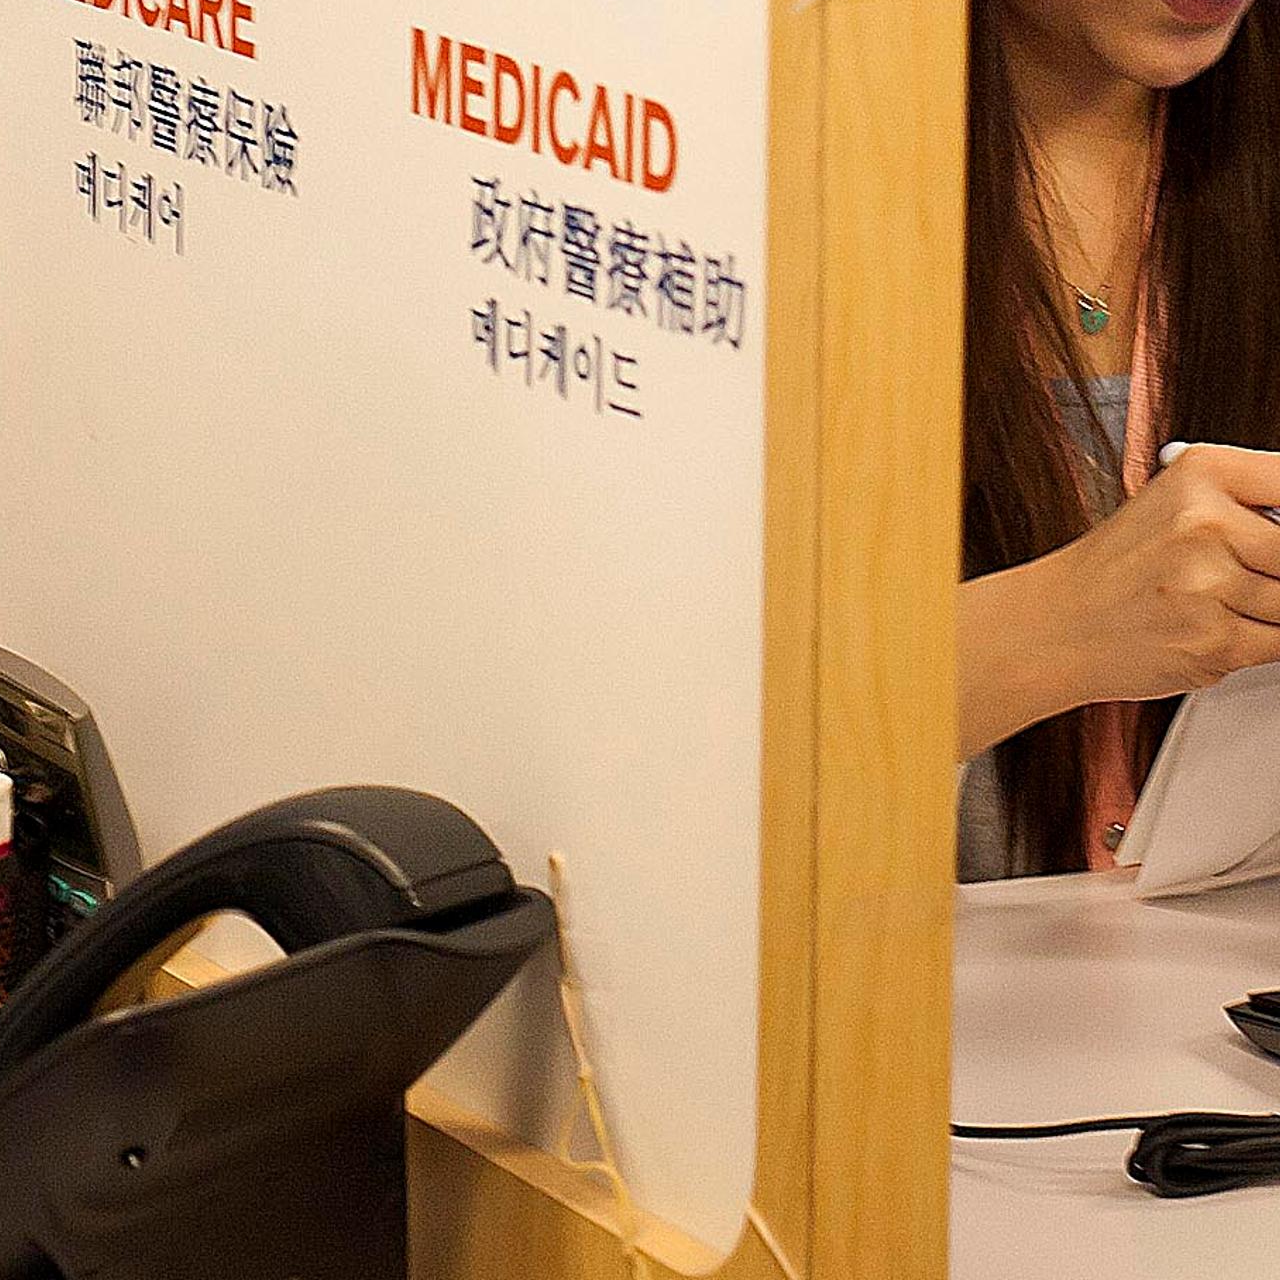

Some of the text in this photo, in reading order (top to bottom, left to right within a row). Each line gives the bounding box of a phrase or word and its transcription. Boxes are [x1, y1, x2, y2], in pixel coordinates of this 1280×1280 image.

[73, 37, 300, 197] 聯邦醫療保險
[410, 26, 680, 194] MEDICAID
[73, 151, 185, 256] 메디케어
[470, 176, 745, 351] 政府醫療補助
[470, 298, 643, 419] 메디케이드
